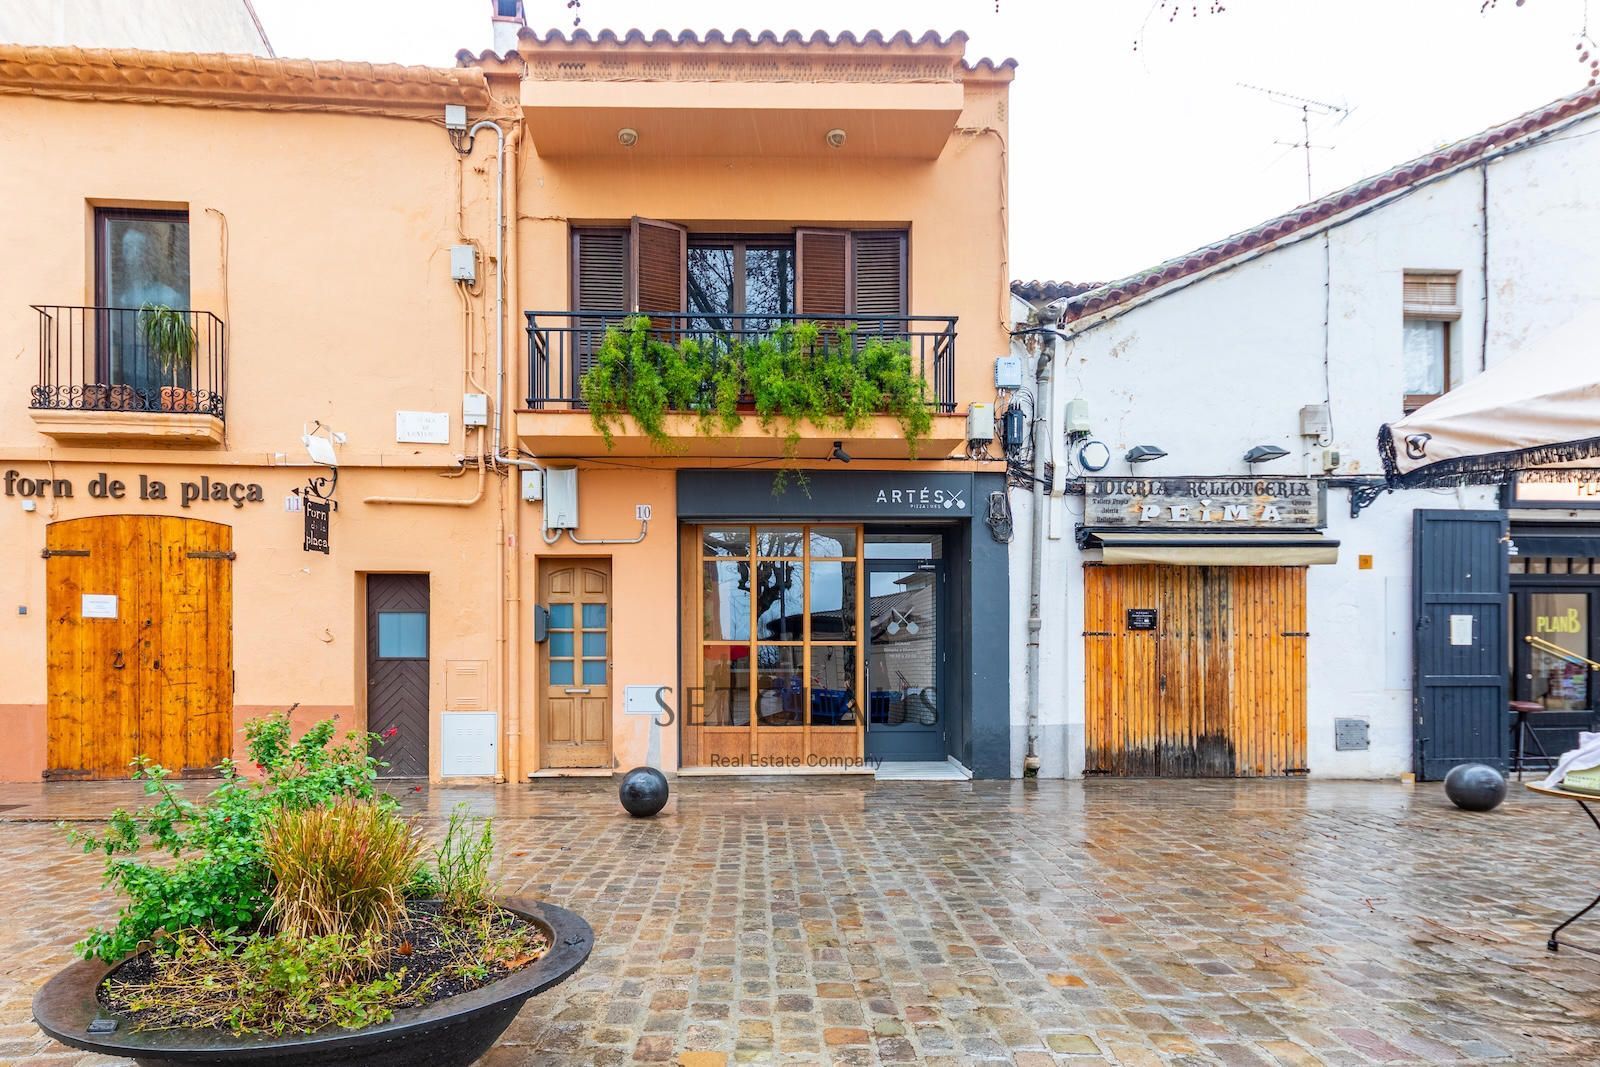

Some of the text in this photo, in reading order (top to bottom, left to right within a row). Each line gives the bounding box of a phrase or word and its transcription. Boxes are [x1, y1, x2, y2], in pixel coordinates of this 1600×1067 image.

[4, 469, 265, 509] forn de la plaça
[876, 486, 944, 503] ARTÉS
[1092, 479, 1312, 499] JOIERIA RELLOTGERIA
[287, 498, 299, 511] 11
[306, 502, 327, 521] forn
[637, 506, 650, 519] 10
[306, 530, 328, 550] plaça
